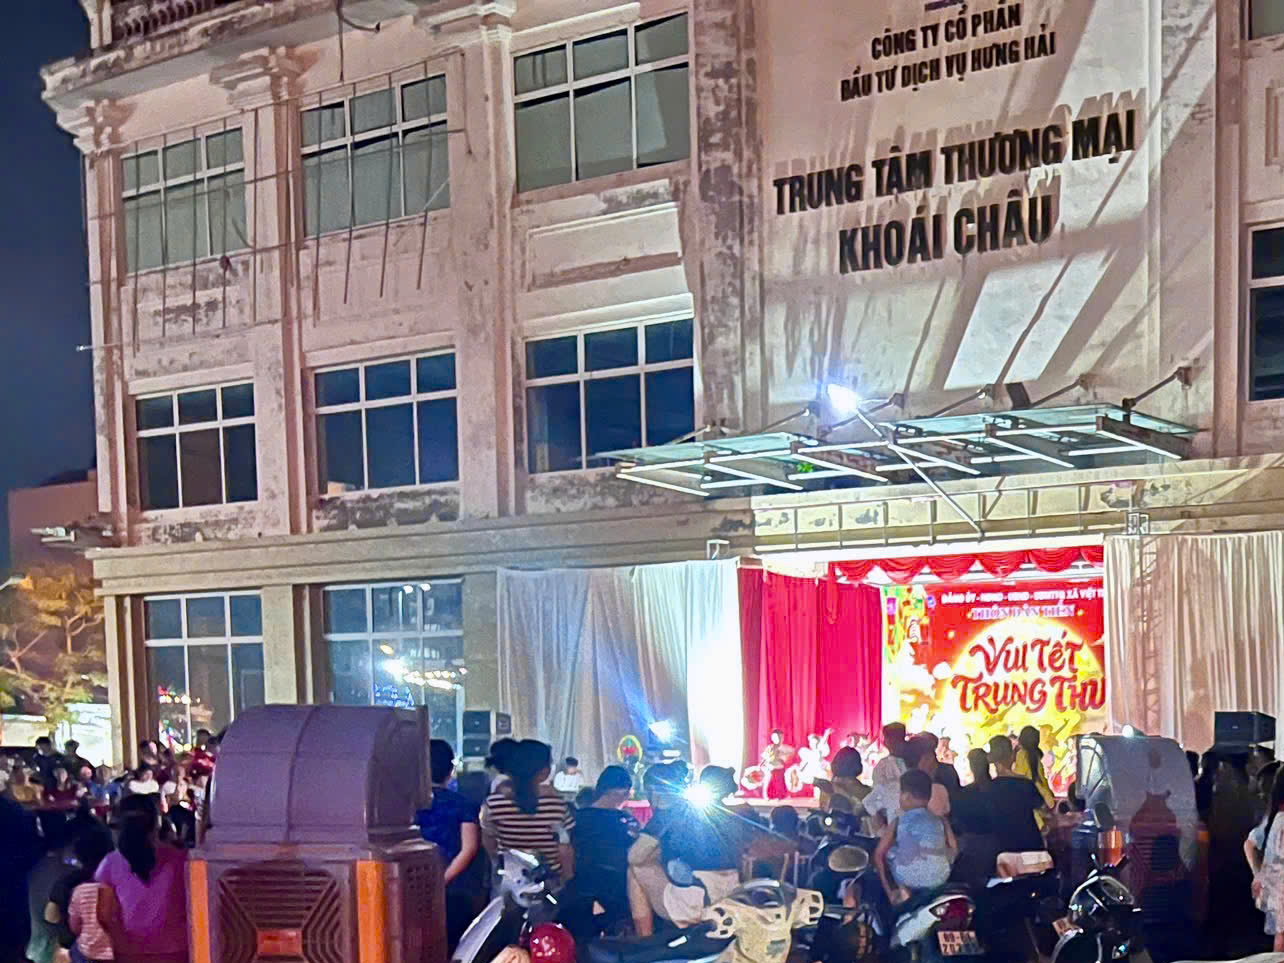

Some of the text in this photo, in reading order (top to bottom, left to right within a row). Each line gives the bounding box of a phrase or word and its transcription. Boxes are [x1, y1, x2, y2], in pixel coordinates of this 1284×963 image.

[871, 28, 916, 60] CÔNG
[920, 22, 940, 49] TY
[944, 4, 968, 43] CỔ
[875, 65, 898, 93] TƯ
[901, 58, 941, 91] DỊCH
[945, 52, 967, 82] VỤ
[971, 40, 1020, 72] HƯNG
[1023, 23, 1057, 60] HẢI
[773, 109, 1136, 215] TRUNG TÂM THƯƠNG MẠI
[838, 188, 1053, 275] KHOÁI CHÂU
[951, 672, 1106, 714] TRUNG THU
